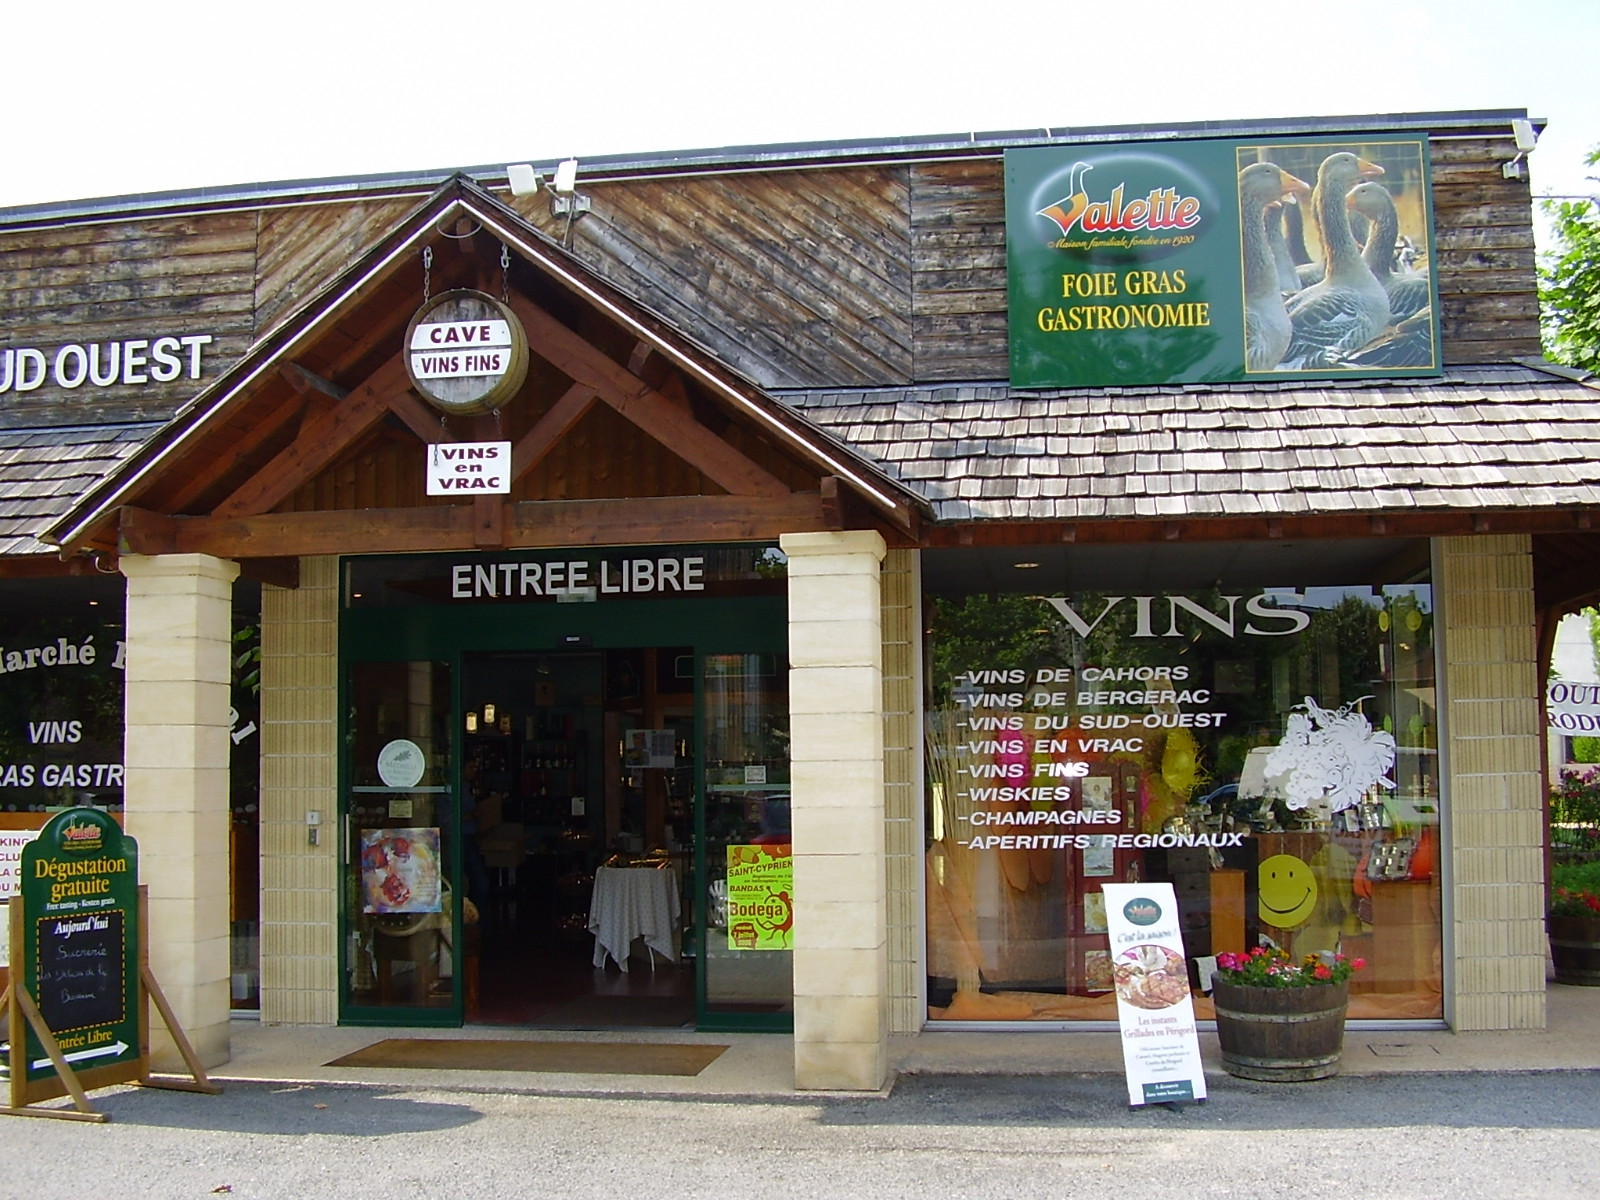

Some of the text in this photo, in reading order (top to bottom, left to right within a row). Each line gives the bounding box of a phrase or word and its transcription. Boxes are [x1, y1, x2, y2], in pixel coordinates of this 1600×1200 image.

[1036, 178, 1202, 237] Valette
[1047, 237, 1087, 249] Maison
[1085, 236, 1128, 251] familiale
[1159, 237, 1172, 246] en
[1172, 234, 1195, 247] 1920
[1062, 268, 1187, 299] FOIE GRAS
[1036, 301, 1211, 332] GASTRONOMIE
[429, 325, 492, 344] CAVE
[55, 334, 212, 389] OUEST
[420, 353, 501, 375] VINS FINS
[440, 446, 500, 460] VINS
[454, 463, 483, 474] en
[437, 476, 501, 490] VRAC
[452, 557, 705, 598] ENTREE LIBRE
[1044, 592, 1311, 639] VINS
[1036, 668, 1071, 685] DE
[1081, 665, 1190, 683] CAHORS
[1033, 692, 1067, 707] DE
[1076, 689, 1211, 706] BERGERAC
[1034, 715, 1069, 731] DU
[1078, 712, 1228, 730] SUD-OUEST
[28, 720, 83, 744] VINS
[1033, 738, 1068, 754] EN
[1077, 737, 1143, 754] VRAC
[42, 763, 124, 787] GASTR
[1033, 761, 1090, 778] FINS
[1101, 831, 1244, 849] REGIONAUX
[35, 855, 127, 882] Dégustation
[728, 860, 793, 878] SAINT-CYPRIEN
[51, 877, 110, 903] gratuite
[729, 901, 783, 919] Bodega
[54, 916, 109, 939] Aujourd'hui
[1138, 1016, 1150, 1025] Les
[87, 1029, 113, 1044] Libre
[1123, 1028, 1155, 1039] Grillades
[1166, 1025, 1195, 1038] Périgord
